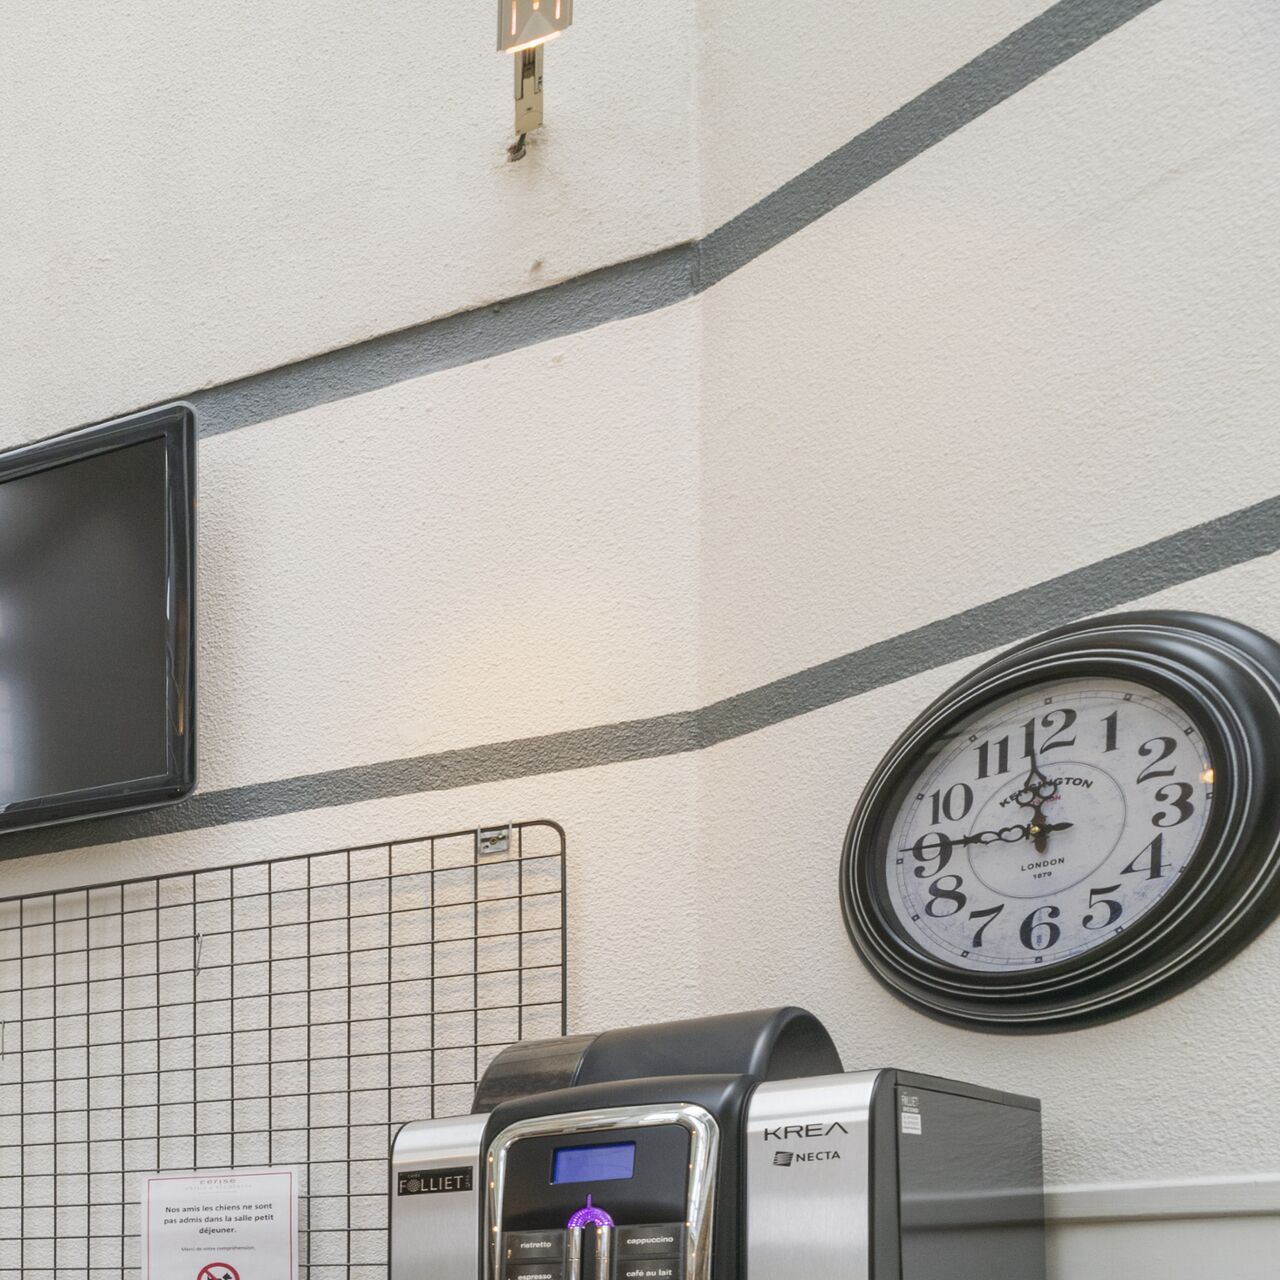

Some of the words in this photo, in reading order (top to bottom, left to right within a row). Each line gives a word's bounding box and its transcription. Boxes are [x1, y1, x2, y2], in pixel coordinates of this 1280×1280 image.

[1019, 707, 1078, 759] 12
[1100, 710, 1119, 753] 1
[973, 735, 1010, 779] 11
[1136, 736, 1178, 784] 2
[928, 782, 974, 824] 10
[1151, 781, 1195, 828] 3
[912, 832, 954, 878] 9
[1020, 857, 1065, 872] LONDON
[1120, 832, 1172, 881] 4
[925, 874, 967, 918] 8
[1081, 884, 1123, 930] 5
[968, 903, 1006, 948] 7
[1019, 905, 1060, 951] 6
[764, 1121, 848, 1141] KREA
[796, 1151, 841, 1162] NECTA
[179, 1216, 202, 1224] admis
[225, 1214, 232, 1222] la
[234, 1214, 252, 1222] salle
[254, 1213, 274, 1222] petit
[215, 1204, 240, 1212] chiens
[198, 1226, 237, 1235] déjeuner.
[520, 1240, 552, 1248] ristretto
[626, 1236, 674, 1244] cappuccino
[658, 1268, 672, 1276] lait
